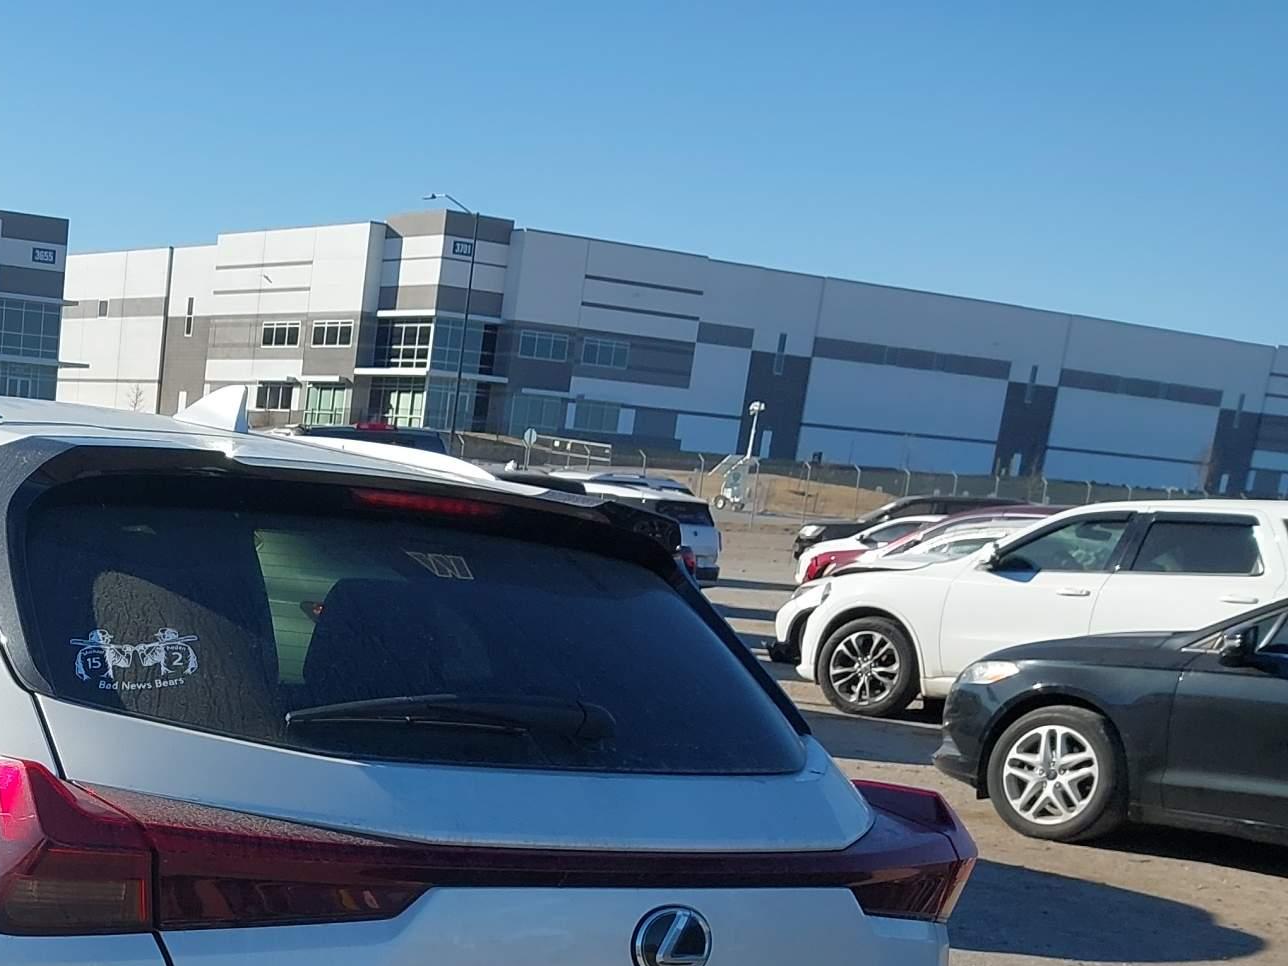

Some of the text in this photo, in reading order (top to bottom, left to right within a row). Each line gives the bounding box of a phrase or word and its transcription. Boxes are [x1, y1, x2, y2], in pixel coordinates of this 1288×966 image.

[86, 657, 102, 669] 15
[171, 652, 184, 666] 2
[98, 677, 185, 691] Bad News Bears
